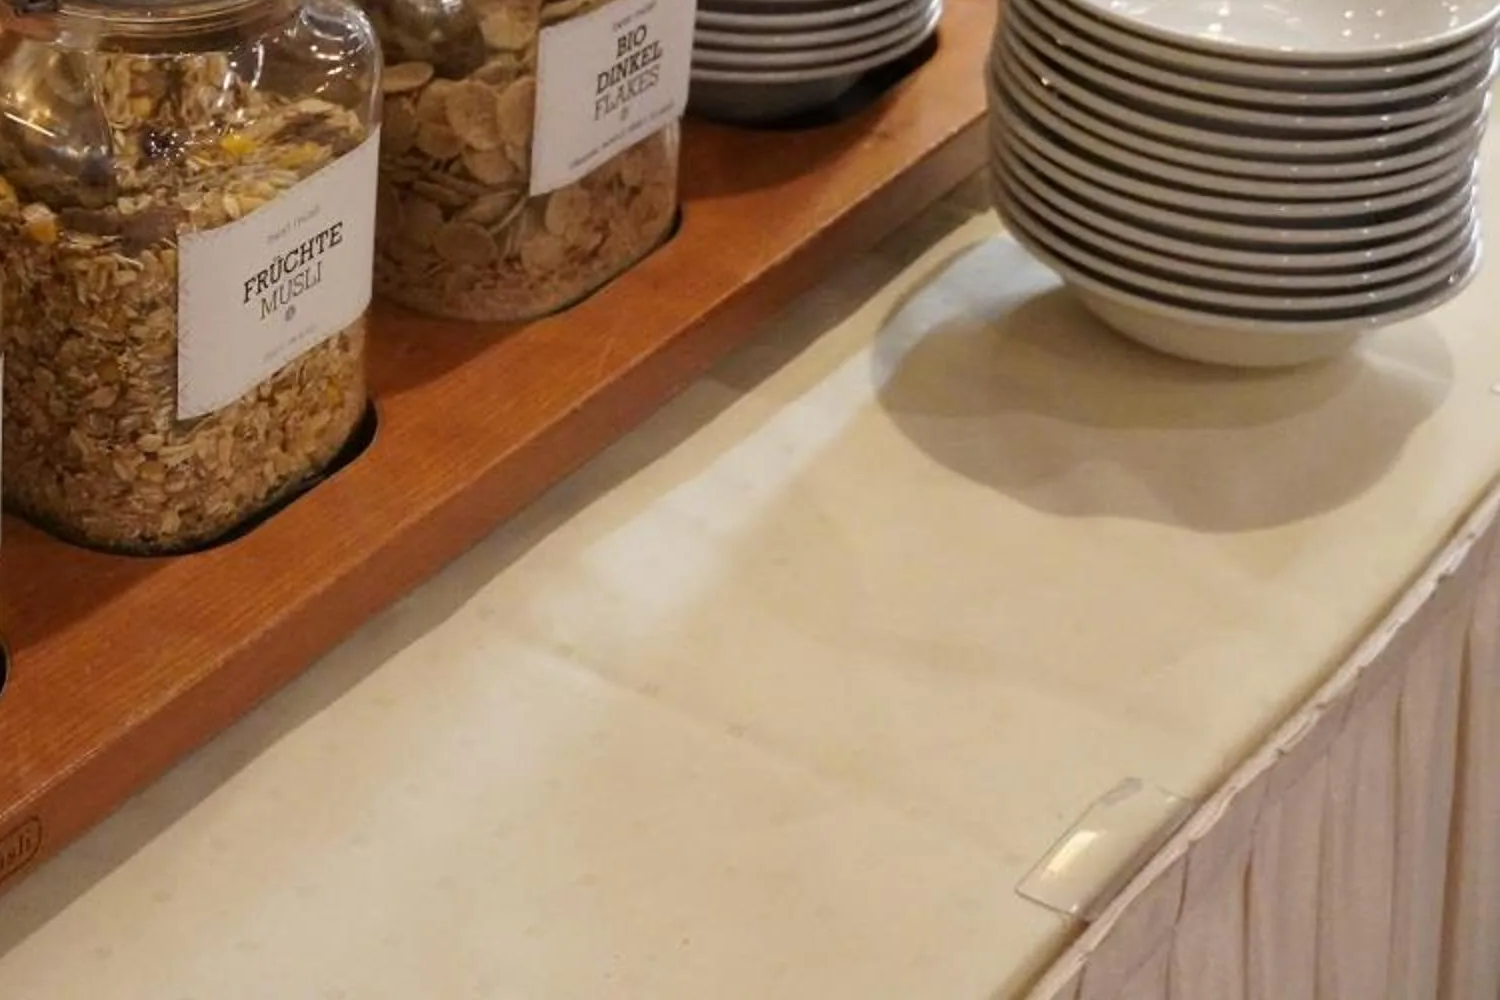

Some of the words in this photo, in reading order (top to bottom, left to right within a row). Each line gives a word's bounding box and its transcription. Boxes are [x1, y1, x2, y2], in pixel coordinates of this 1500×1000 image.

[596, 40, 664, 95] DINKEL
[615, 24, 648, 60] BIO
[594, 64, 661, 121] FLAKES
[243, 221, 343, 304] FRÜCHTE
